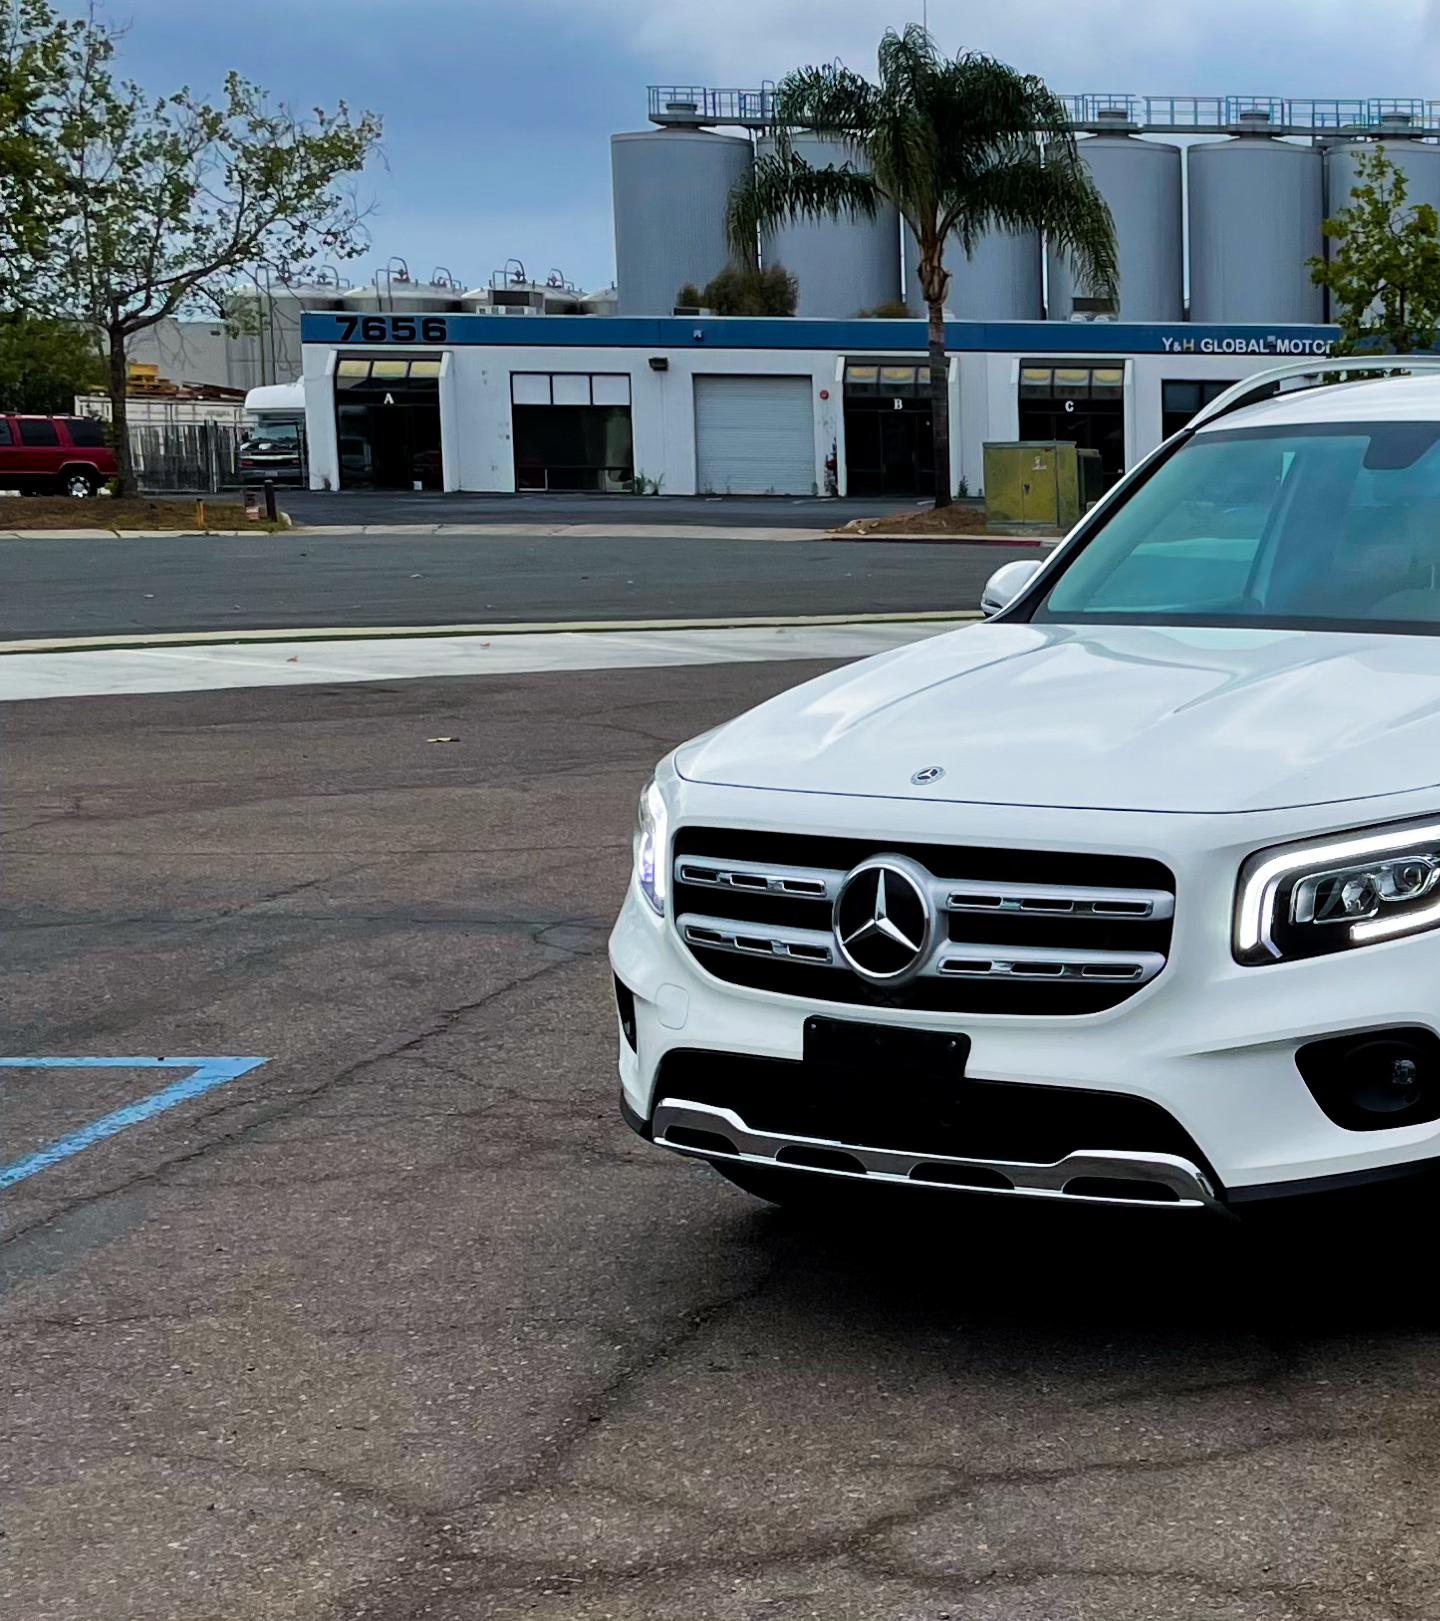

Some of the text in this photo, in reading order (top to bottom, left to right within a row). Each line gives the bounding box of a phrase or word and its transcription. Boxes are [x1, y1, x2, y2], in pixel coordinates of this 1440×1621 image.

[335, 316, 447, 342] 7656
[1162, 337, 1195, 352] Y&H
[1200, 338, 1269, 353] GLOBAL
[383, 392, 395, 405] A
[894, 398, 904, 411] B
[1065, 400, 1075, 412] C
